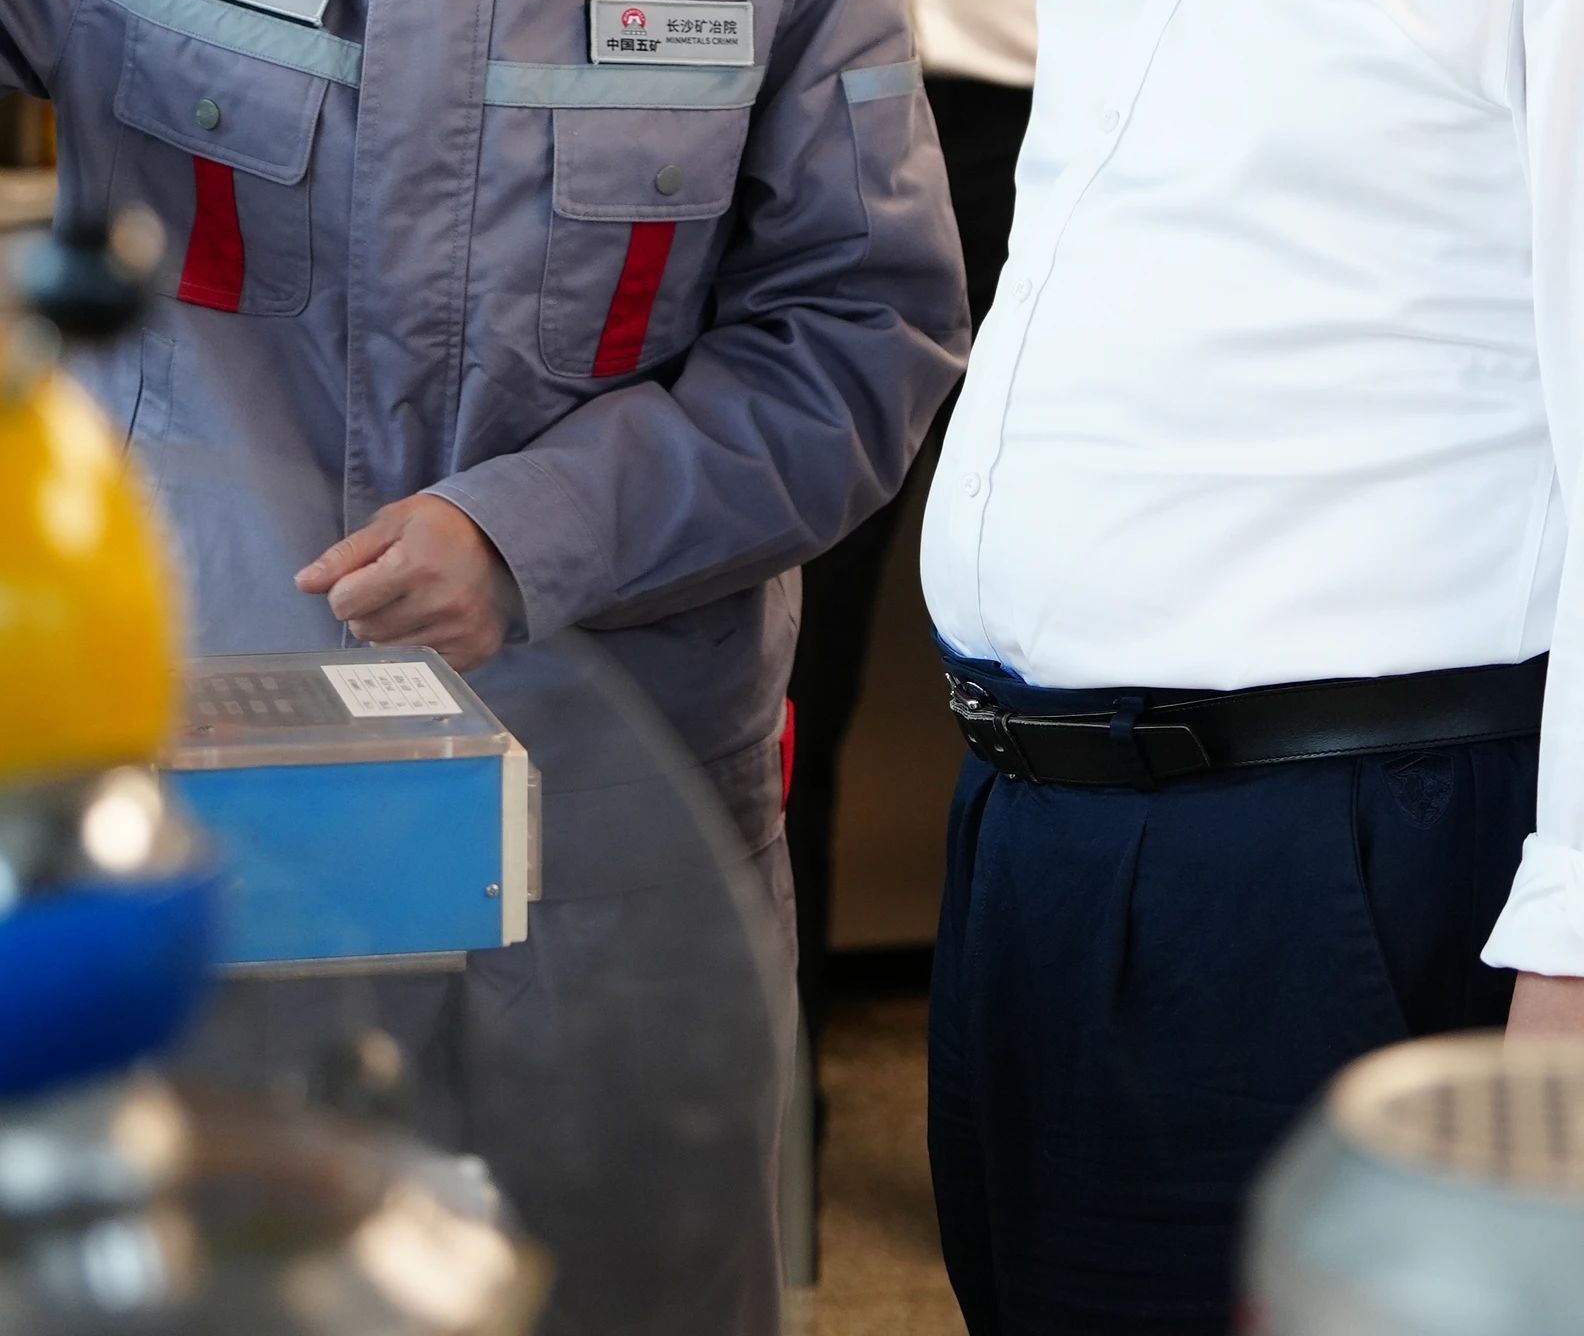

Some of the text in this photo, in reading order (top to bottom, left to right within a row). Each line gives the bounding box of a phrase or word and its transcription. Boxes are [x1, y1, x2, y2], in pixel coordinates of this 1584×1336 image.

[667, 19, 737, 34] 长沙矿冶院
[607, 38, 661, 52] 中国五矿
